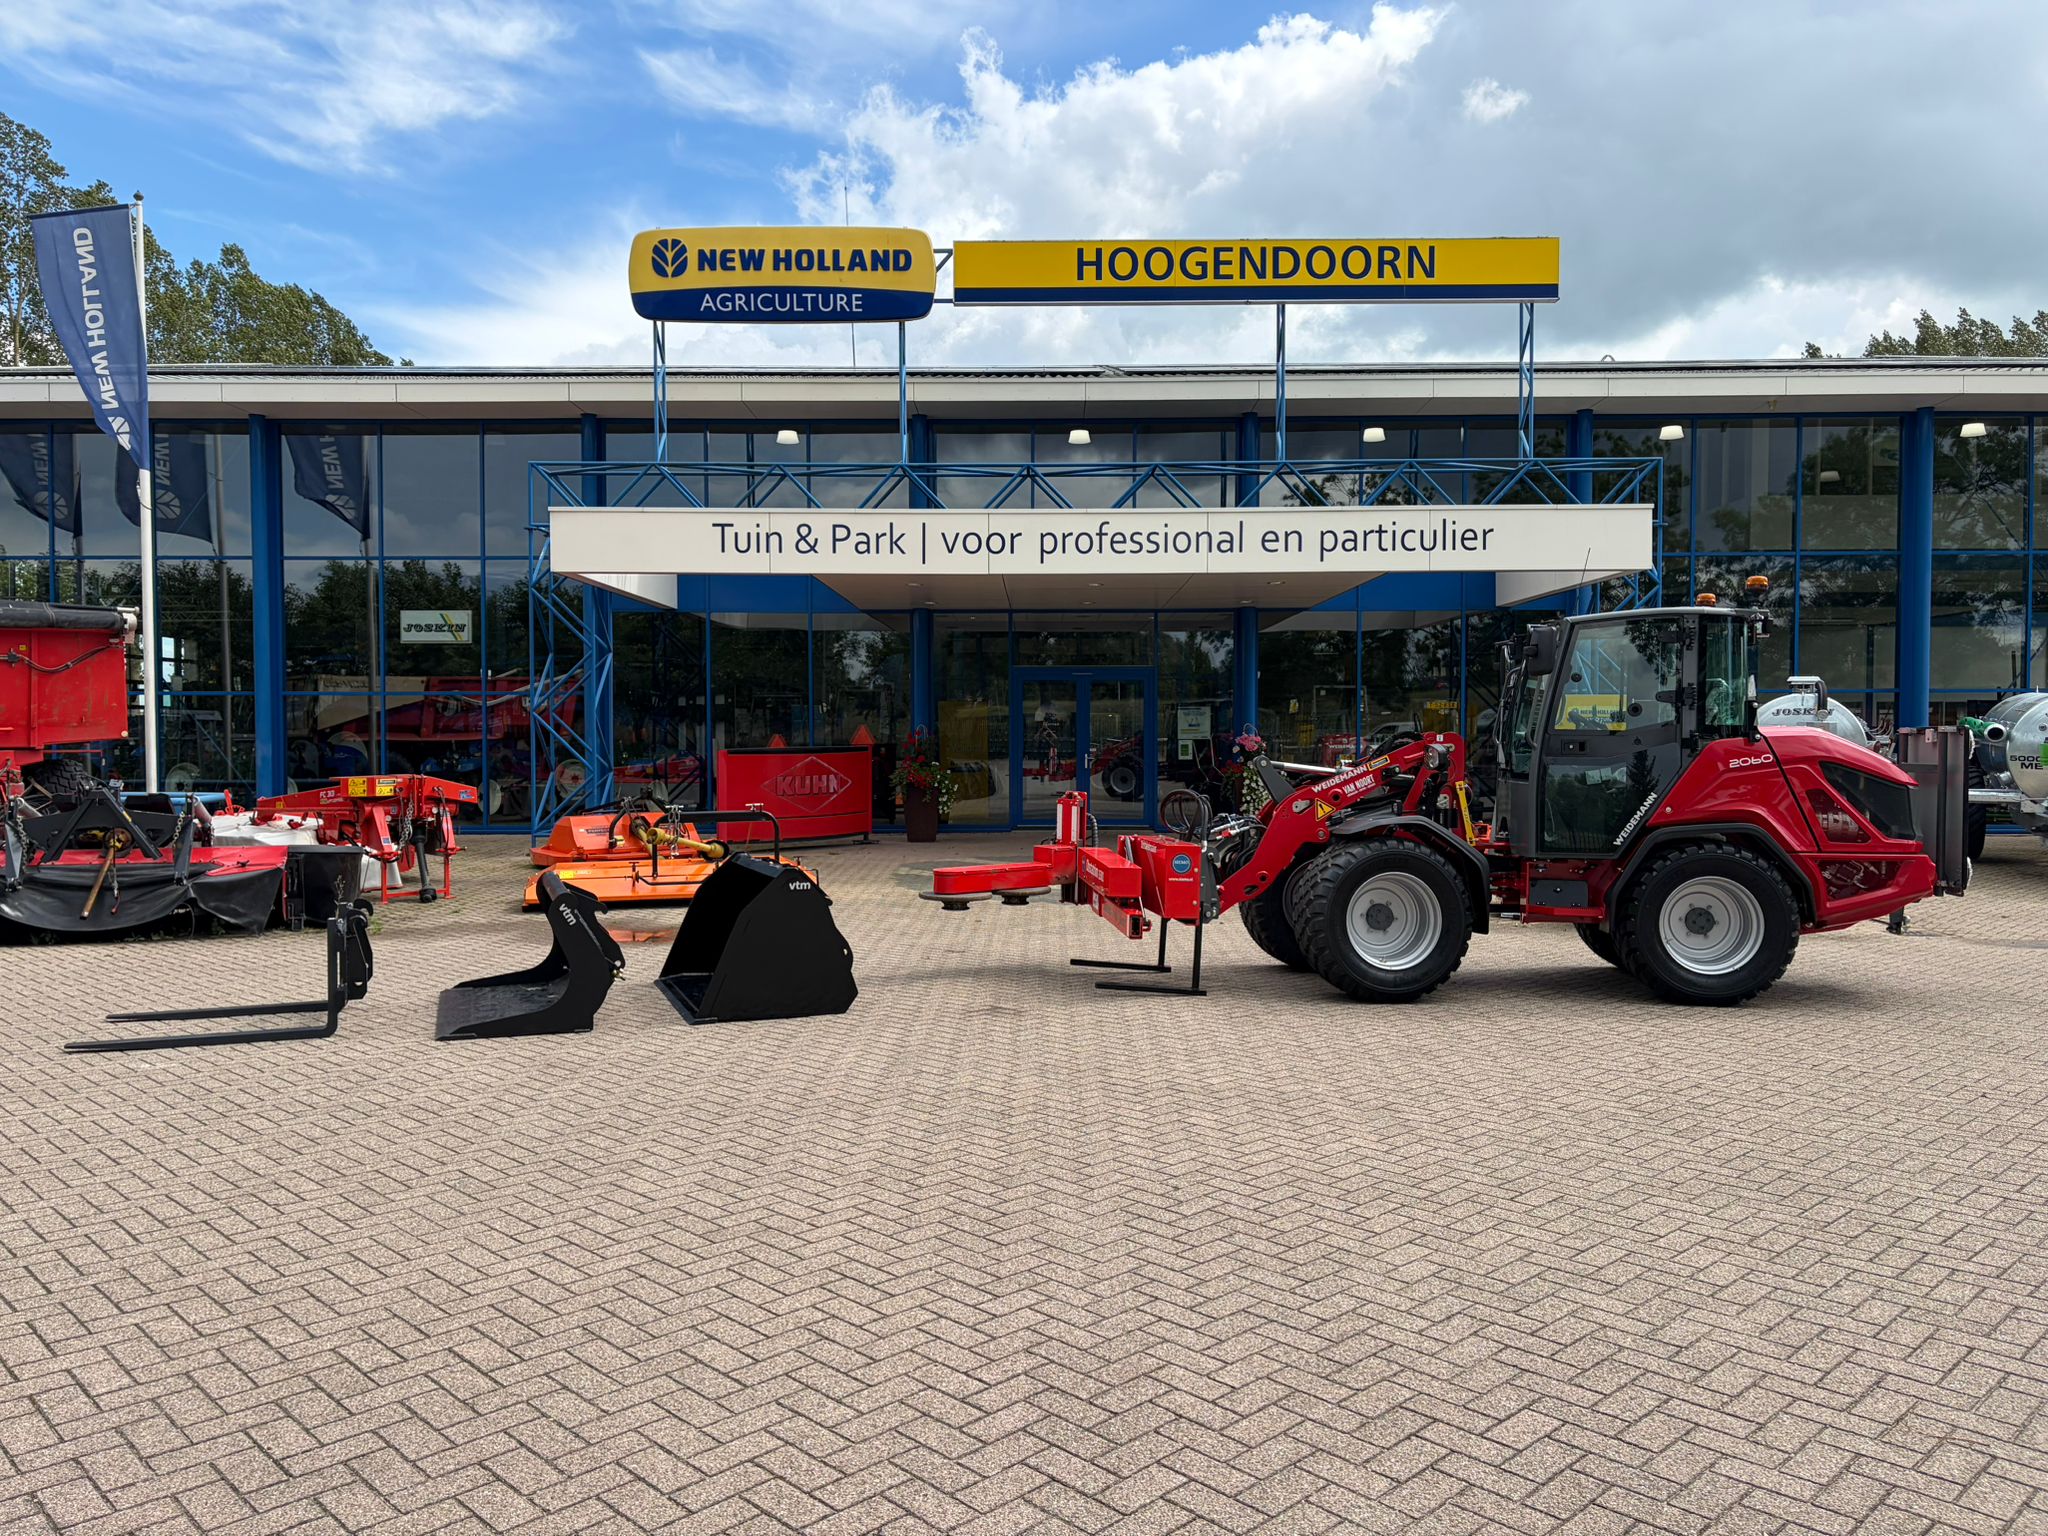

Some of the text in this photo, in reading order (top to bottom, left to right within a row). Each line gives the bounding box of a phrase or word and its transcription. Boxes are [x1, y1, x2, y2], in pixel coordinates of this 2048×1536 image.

[697, 248, 913, 272] NEW HOLLAND
[1076, 245, 1436, 281] HOOGENDOORN
[700, 293, 863, 313] AGRICULTURE
[712, 523, 783, 554] Tuin
[794, 523, 819, 554] &
[832, 522, 906, 555] Park
[941, 531, 1022, 555] voor
[1040, 520, 1244, 565] professional
[1260, 528, 1303, 553] en
[1319, 518, 1494, 562] particulier
[403, 623, 467, 633] JOSKIN
[1772, 707, 1835, 717] JOSKN
[1729, 754, 1774, 768] 2060
[776, 774, 841, 796] KUHN
[1312, 764, 1368, 793] WEIDEMANN
[1342, 782, 1355, 794] VAN
[1613, 791, 1658, 846] WEIDEMANN
[789, 881, 811, 890] vtm
[558, 903, 577, 926] vtm
